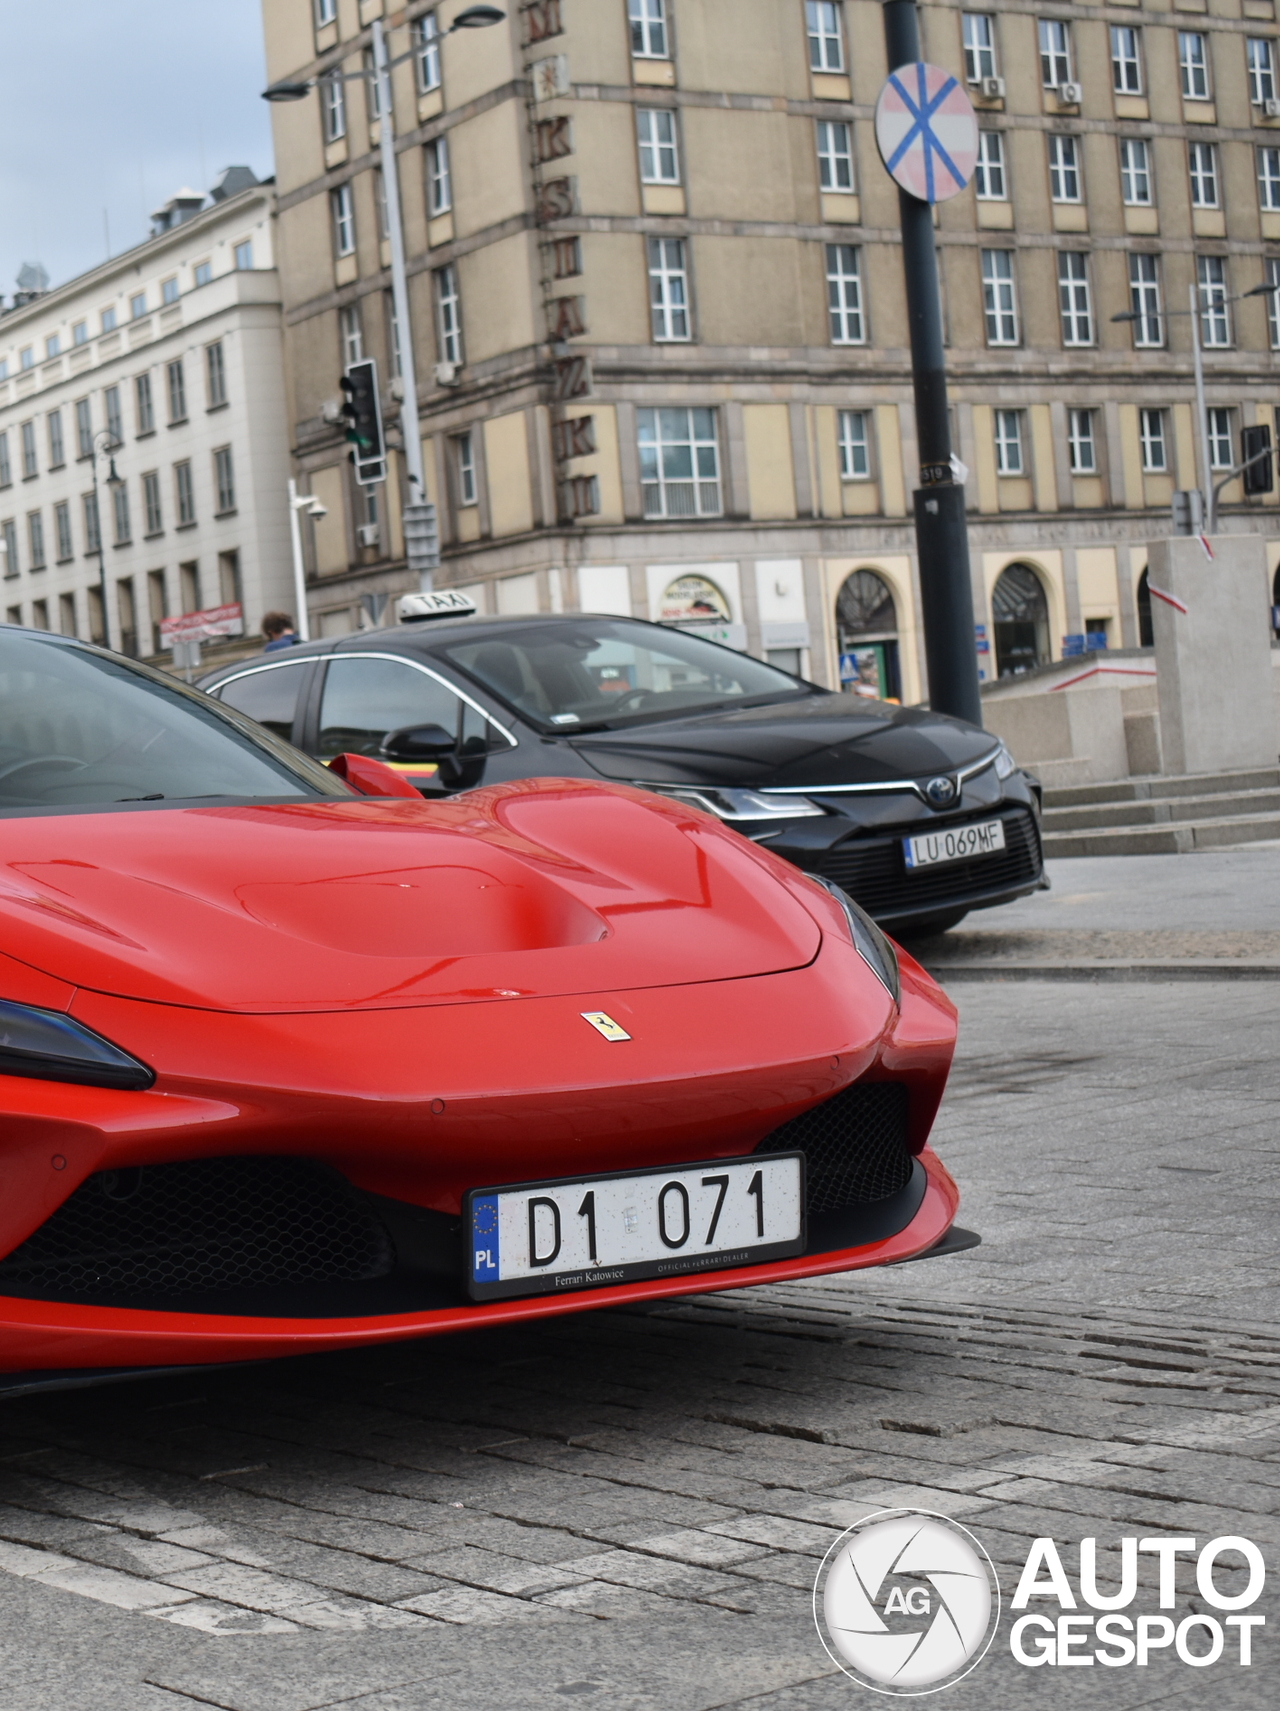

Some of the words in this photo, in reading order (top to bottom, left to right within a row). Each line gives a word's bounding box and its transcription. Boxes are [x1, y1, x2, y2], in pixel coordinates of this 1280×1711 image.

[415, 593, 469, 609] TAXI
[915, 837, 939, 863] LU
[945, 824, 997, 856] 069MF
[528, 1190, 597, 1268] D1
[658, 1170, 765, 1249] 071
[475, 1249, 496, 1270] PL
[658, 1262, 691, 1272] OFFICIAL
[723, 1252, 749, 1263] DEALER
[555, 1274, 583, 1287] Ferrari
[585, 1268, 624, 1283] Katowice
